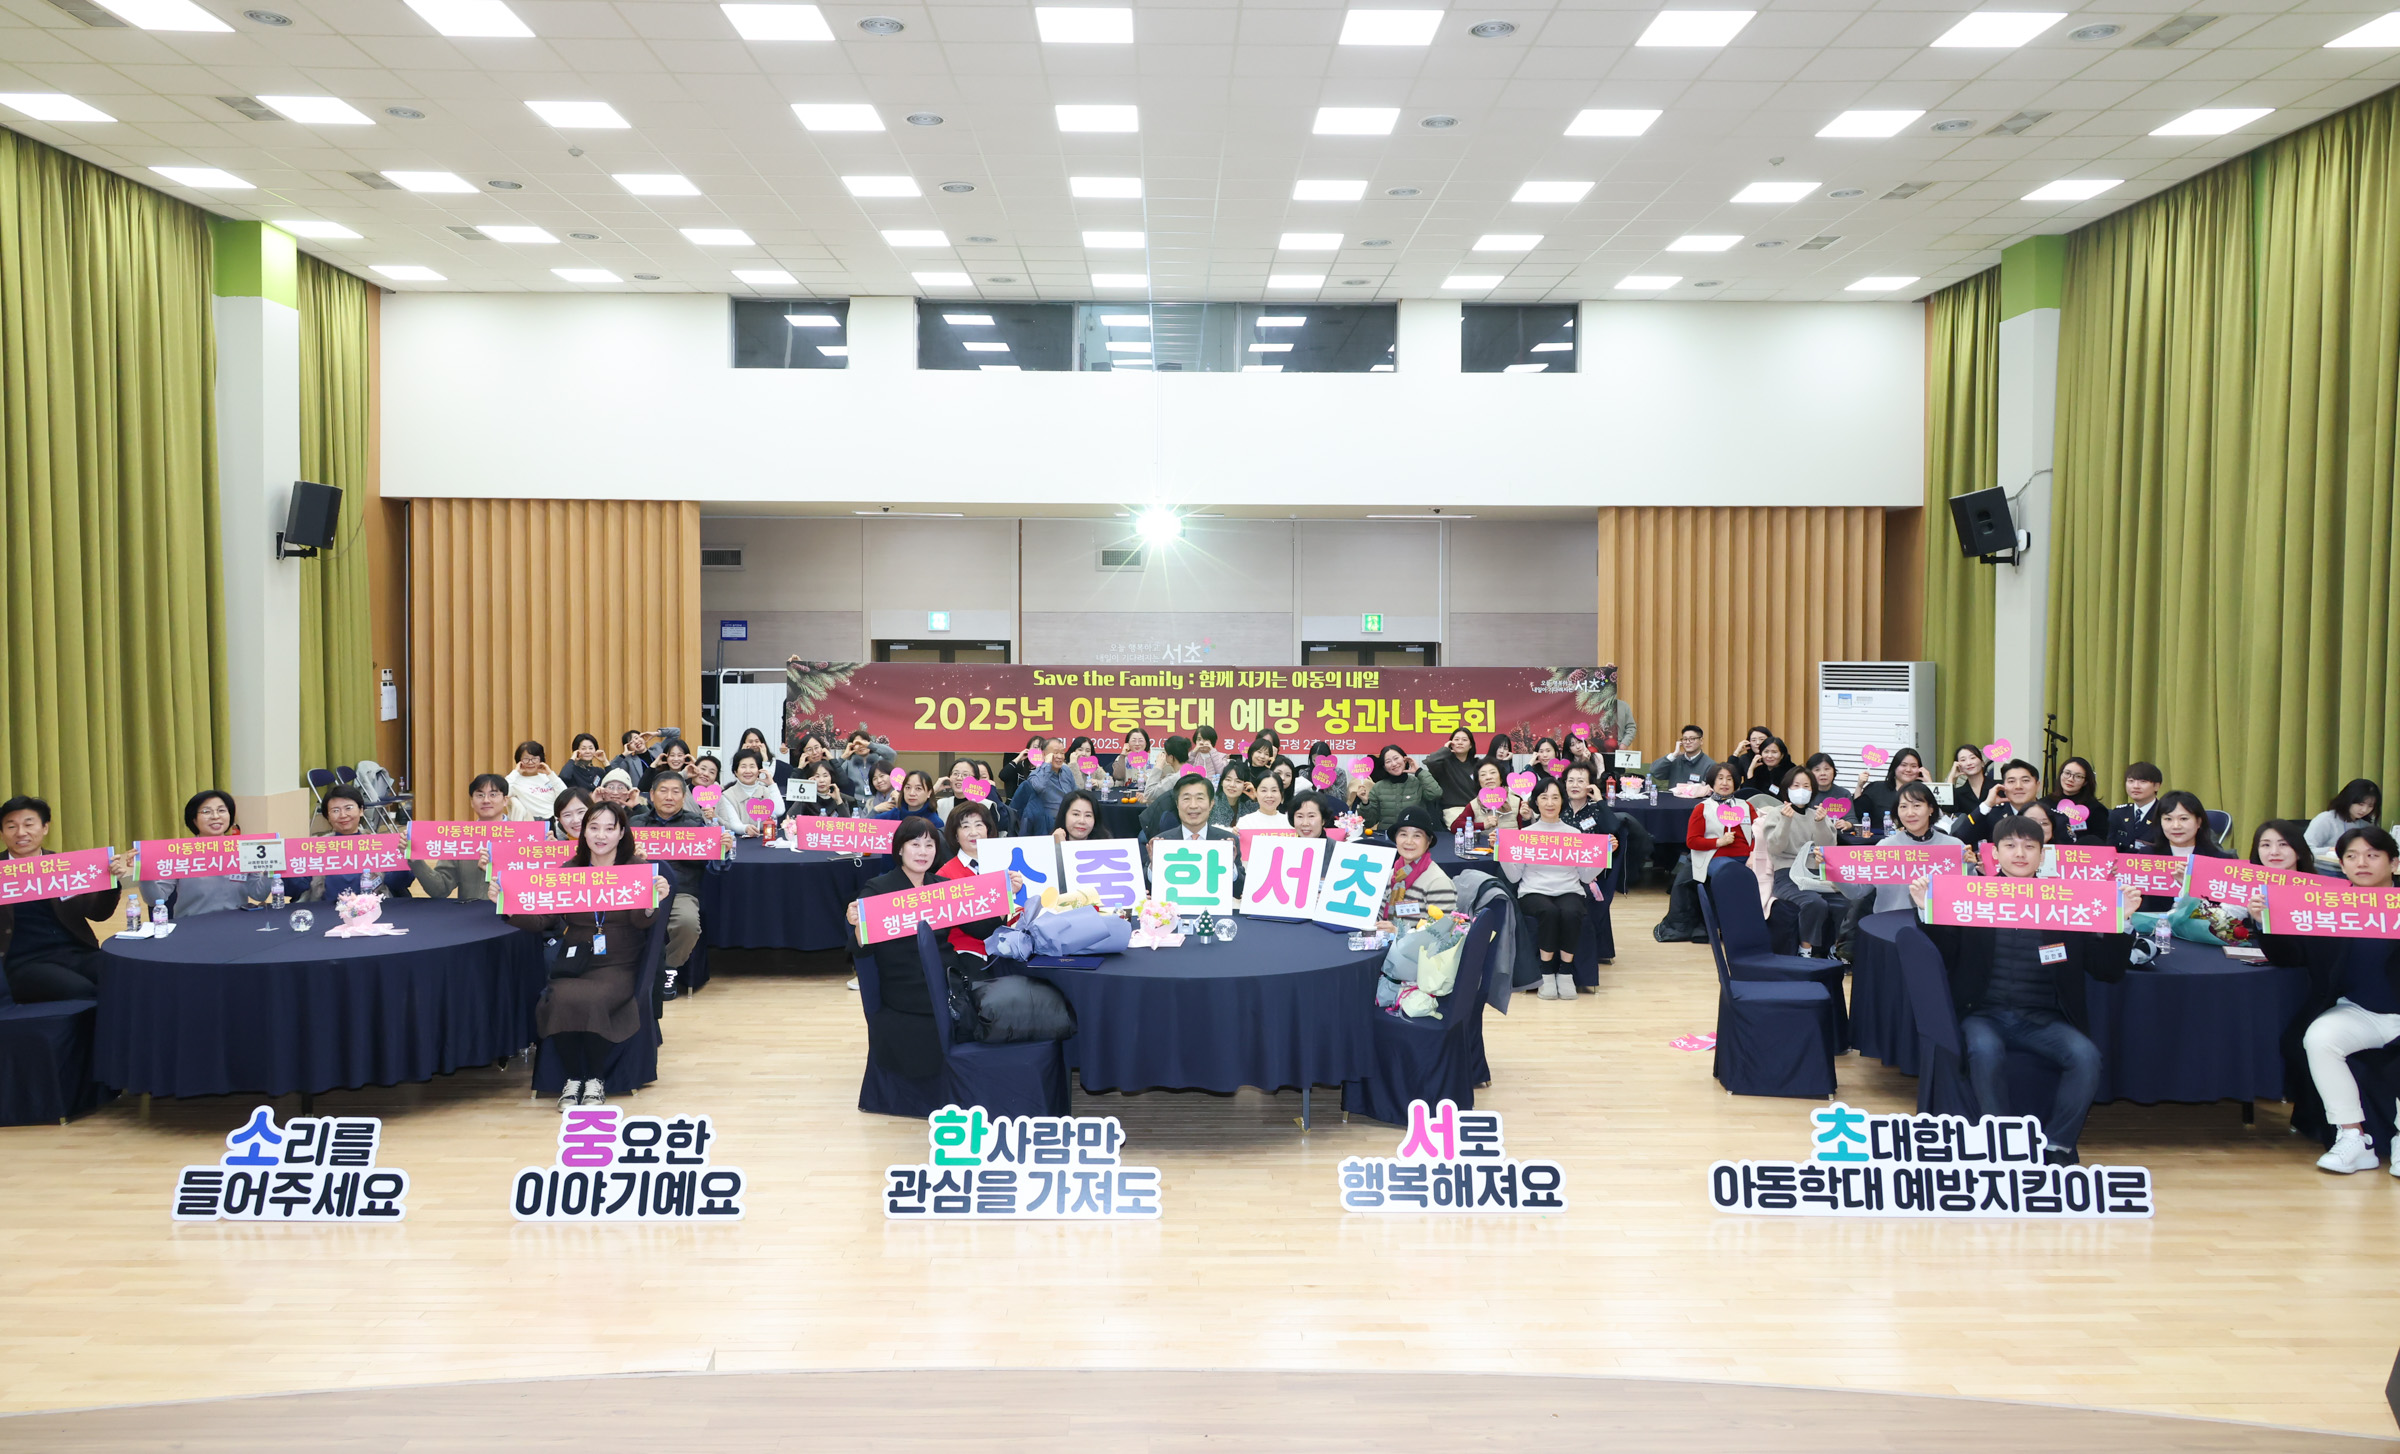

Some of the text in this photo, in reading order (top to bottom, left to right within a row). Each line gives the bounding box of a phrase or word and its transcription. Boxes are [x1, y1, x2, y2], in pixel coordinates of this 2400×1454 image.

[1162, 642, 1203, 664] 서초
[1033, 670, 1080, 687] Save
[1082, 670, 1115, 687] the
[1119, 670, 1184, 690] Family
[1199, 671, 1234, 689] 함께
[1237, 671, 1288, 689] 지키는
[1291, 671, 1341, 689] 아동의
[1346, 671, 1379, 689] 내일
[913, 695, 1496, 735] 2025년 아동학대 예방 성과나눔회
[1624, 754, 1631, 762] 7
[798, 784, 806, 794] 6
[1932, 786, 1940, 795] 4
[437, 825, 515, 838] 아동학대 없는
[674, 830, 696, 840] 없는
[816, 820, 878, 834] 아동학대 없는
[168, 840, 219, 856] 아동학대
[301, 838, 384, 854] 아동학대 없는
[678, 841, 707, 856] 서초
[806, 832, 888, 850] 행복도시 서초
[1518, 834, 1583, 848] 아동학대 없는
[256, 845, 266, 859] 3
[290, 850, 398, 874] 행복도시 서초
[518, 846, 570, 858] 아동학대
[1509, 846, 1594, 864] 행복도시 서초
[1849, 850, 1930, 862] 아동학대 없는
[2064, 850, 2092, 863] 없는
[0, 858, 72, 878] 학대 없는
[156, 854, 224, 877] 행복도시
[1840, 864, 1906, 882] 행복도시
[2070, 864, 2107, 881] 서초
[2224, 865, 2287, 886] 아동학대
[48, 870, 91, 892] 서초
[530, 871, 619, 888] 아동학대 없는
[1074, 848, 1137, 908] 중
[1163, 847, 1227, 906] 한
[1251, 846, 1314, 909] 서
[1326, 853, 1383, 918] 초
[517, 885, 635, 912] 행복도시 서초
[892, 883, 976, 910] 아동학대 없는
[1966, 881, 2074, 902] 아동학대 없는
[2304, 891, 2378, 909] 아동학대
[882, 895, 992, 936] 행복도시 서초
[1952, 900, 2093, 926] 행복도시 서초
[2290, 910, 2386, 934] 행복도시
[225, 1110, 376, 1167] 소리를
[561, 1110, 711, 1167] 중요한
[933, 1110, 1121, 1168] 한사람만
[1401, 1104, 1502, 1161] 서로
[1816, 1107, 2043, 1165] 초대합니다
[176, 1170, 405, 1217] 들어주세요
[515, 1170, 742, 1218] 이야기예요
[886, 1169, 1160, 1216] 관심을 가져도
[1342, 1162, 1565, 1209] 행복해져요
[1713, 1165, 2150, 1214] 아동학대 예방지킴이로
